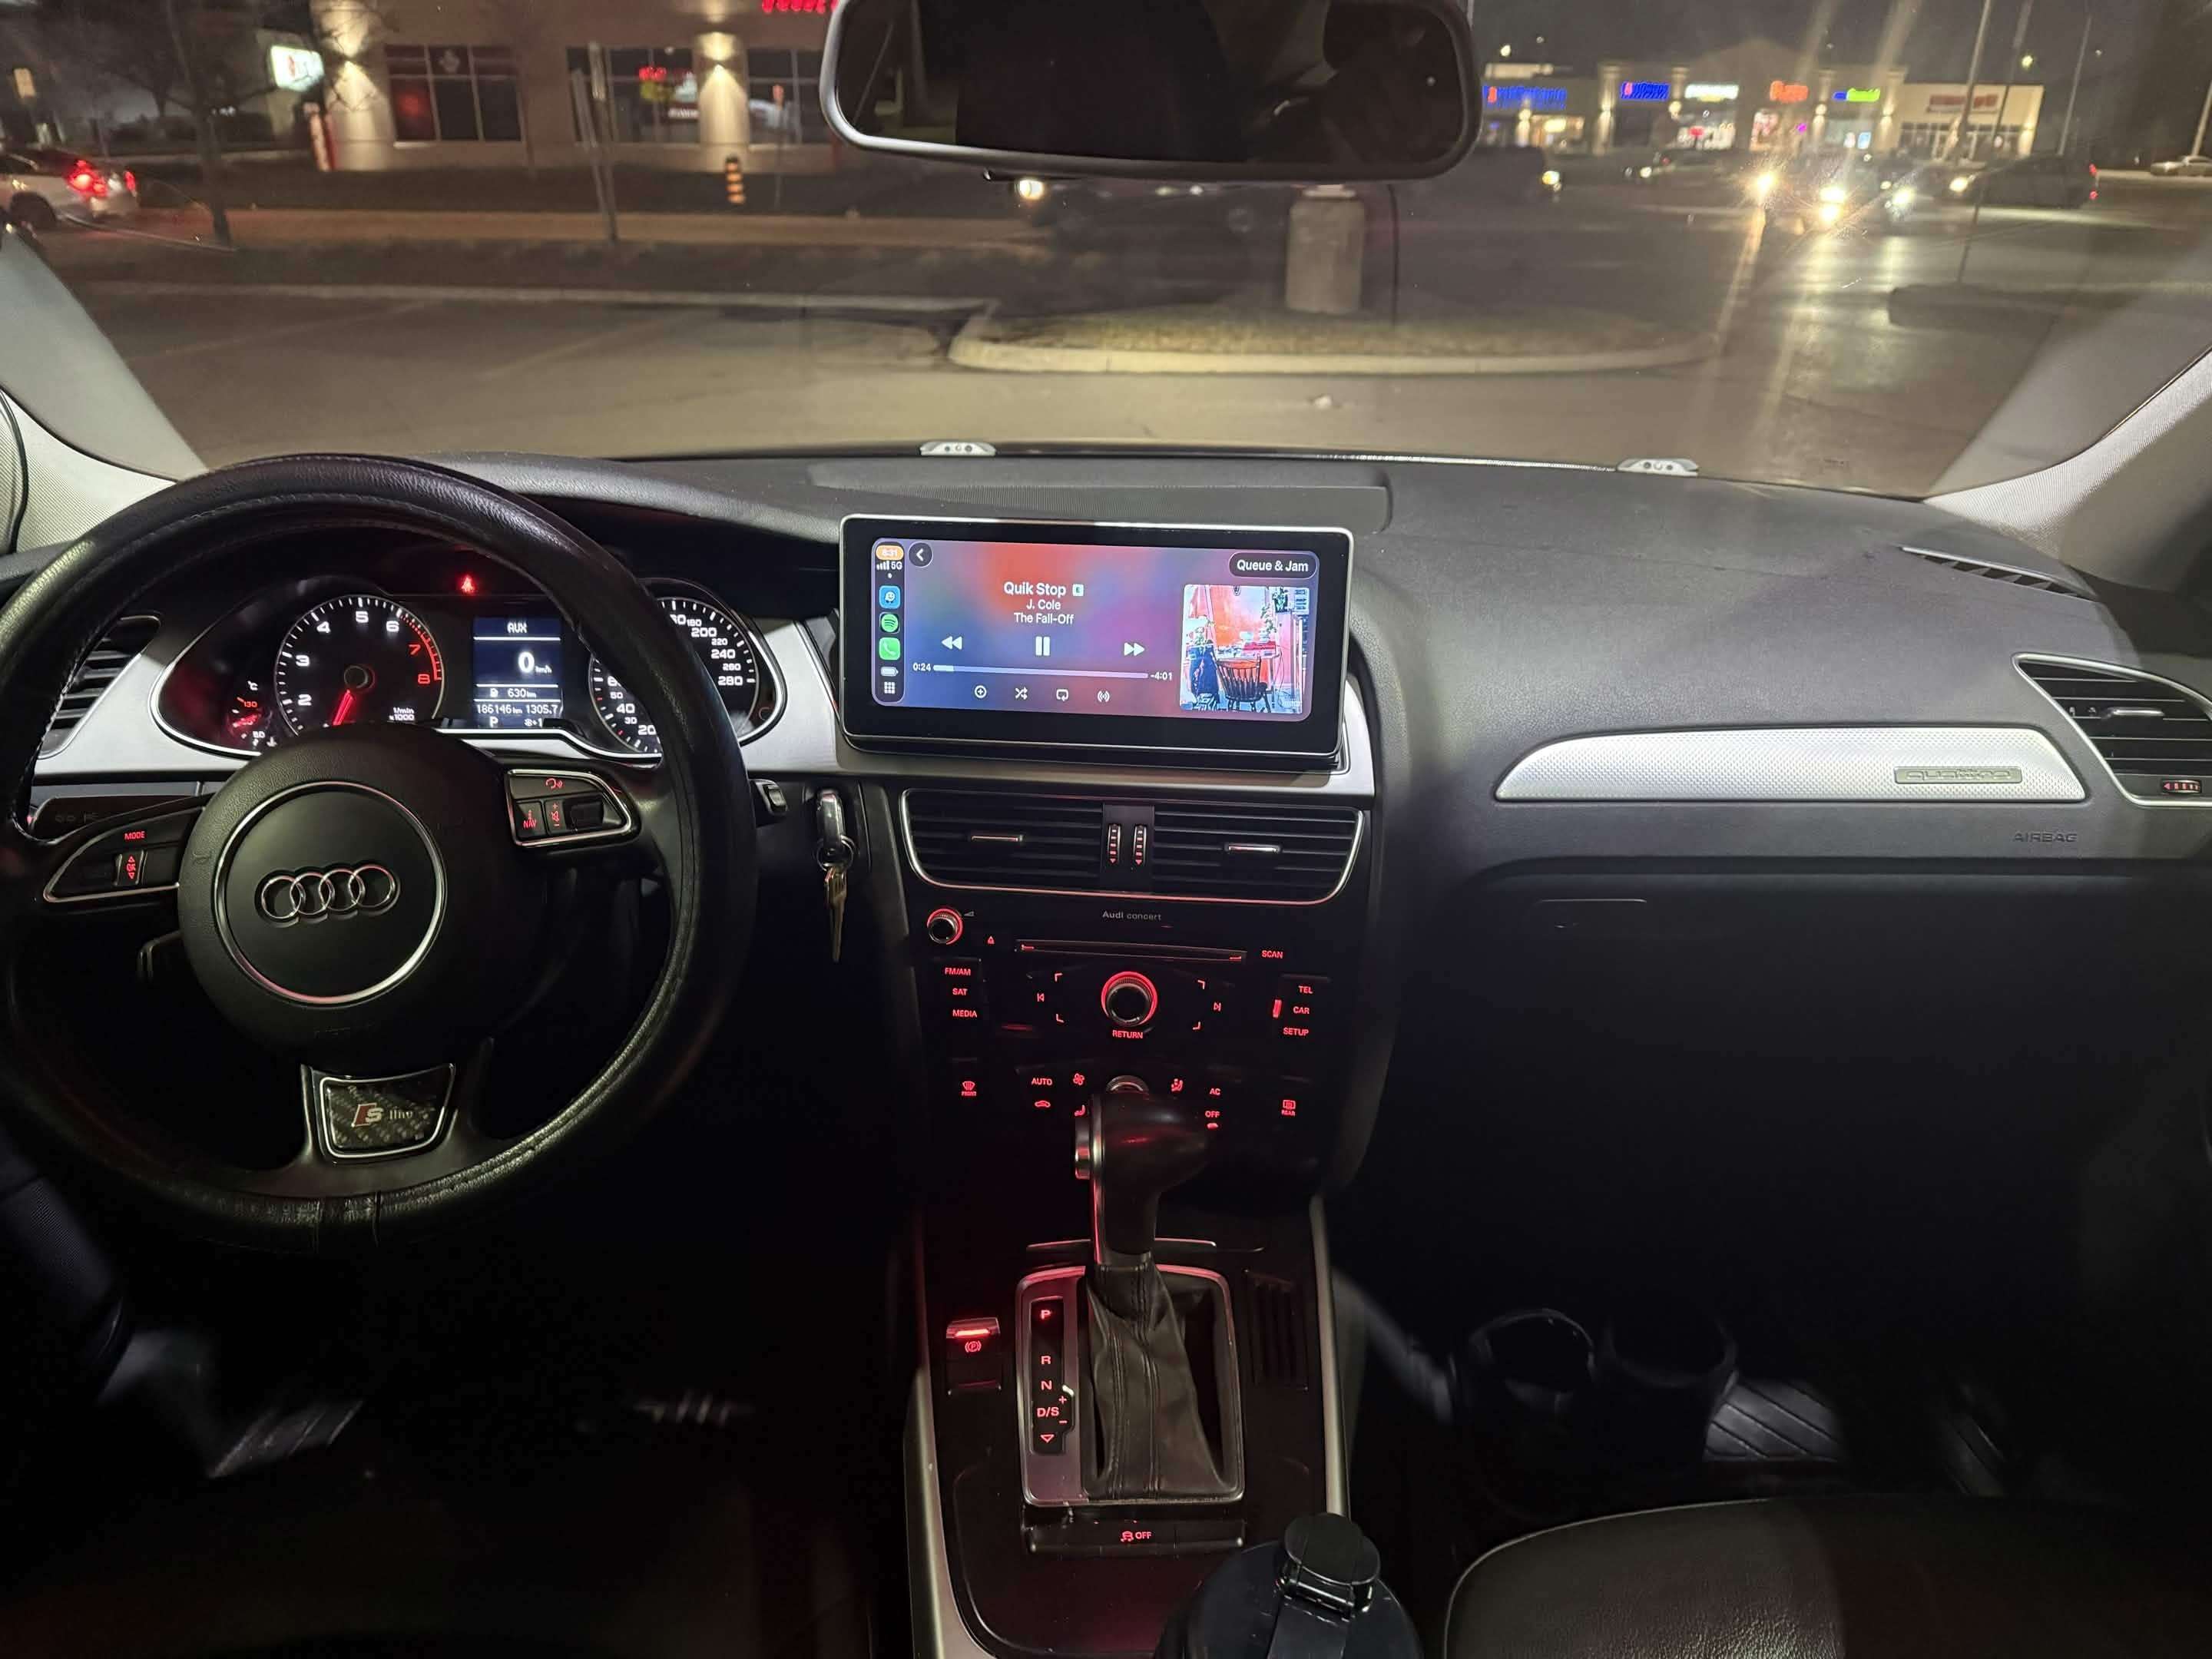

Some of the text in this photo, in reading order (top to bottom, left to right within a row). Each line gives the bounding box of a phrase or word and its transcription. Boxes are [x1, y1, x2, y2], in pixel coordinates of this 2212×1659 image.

[891, 561, 902, 570] 5G
[1237, 559, 1309, 572] Queue & Jam
[1004, 581, 1034, 595] Quik
[1036, 583, 1067, 598] Stop
[1026, 599, 1061, 611] J. Cole
[355, 611, 369, 623] 5
[1014, 613, 1075, 624] The Fall-Off
[316, 621, 330, 634] 4
[386, 620, 399, 632] 6
[507, 622, 528, 633] AUX
[691, 627, 717, 637] 200
[409, 644, 421, 656] 7
[711, 649, 736, 659] 240
[296, 654, 310, 667] 3
[518, 651, 535, 673] 0
[723, 663, 741, 671] 260
[912, 662, 932, 672] 0:24
[417, 674, 430, 684] 8
[717, 676, 743, 686] 280
[1150, 671, 1173, 681] -4:01
[297, 694, 312, 706] 2
[525, 704, 558, 714] 1305.7
[616, 704, 635, 714] 40
[489, 717, 498, 728] P
[637, 724, 657, 736] 20
[523, 820, 536, 828] NAV
[124, 830, 145, 840] MODE
[2013, 832, 2078, 843] AIRBAG
[1102, 910, 1161, 921] Audi concert
[1261, 949, 1283, 959] SCAN
[945, 967, 971, 976] FM/AM
[952, 988, 968, 996] SAT
[1298, 985, 1313, 994] TEL
[952, 1008, 977, 1018] MEDIA
[1293, 1005, 1310, 1015] CAR
[1112, 1029, 1144, 1039] RETURN
[1283, 1027, 1309, 1037] SETUP
[1031, 1078, 1053, 1086] AUTO
[1209, 1088, 1221, 1096] AC
[1040, 1309, 1051, 1320] P
[1040, 1355, 1051, 1365] R
[1040, 1380, 1053, 1391] N
[1037, 1406, 1060, 1418] D/S
[1134, 1532, 1152, 1540] OFF
